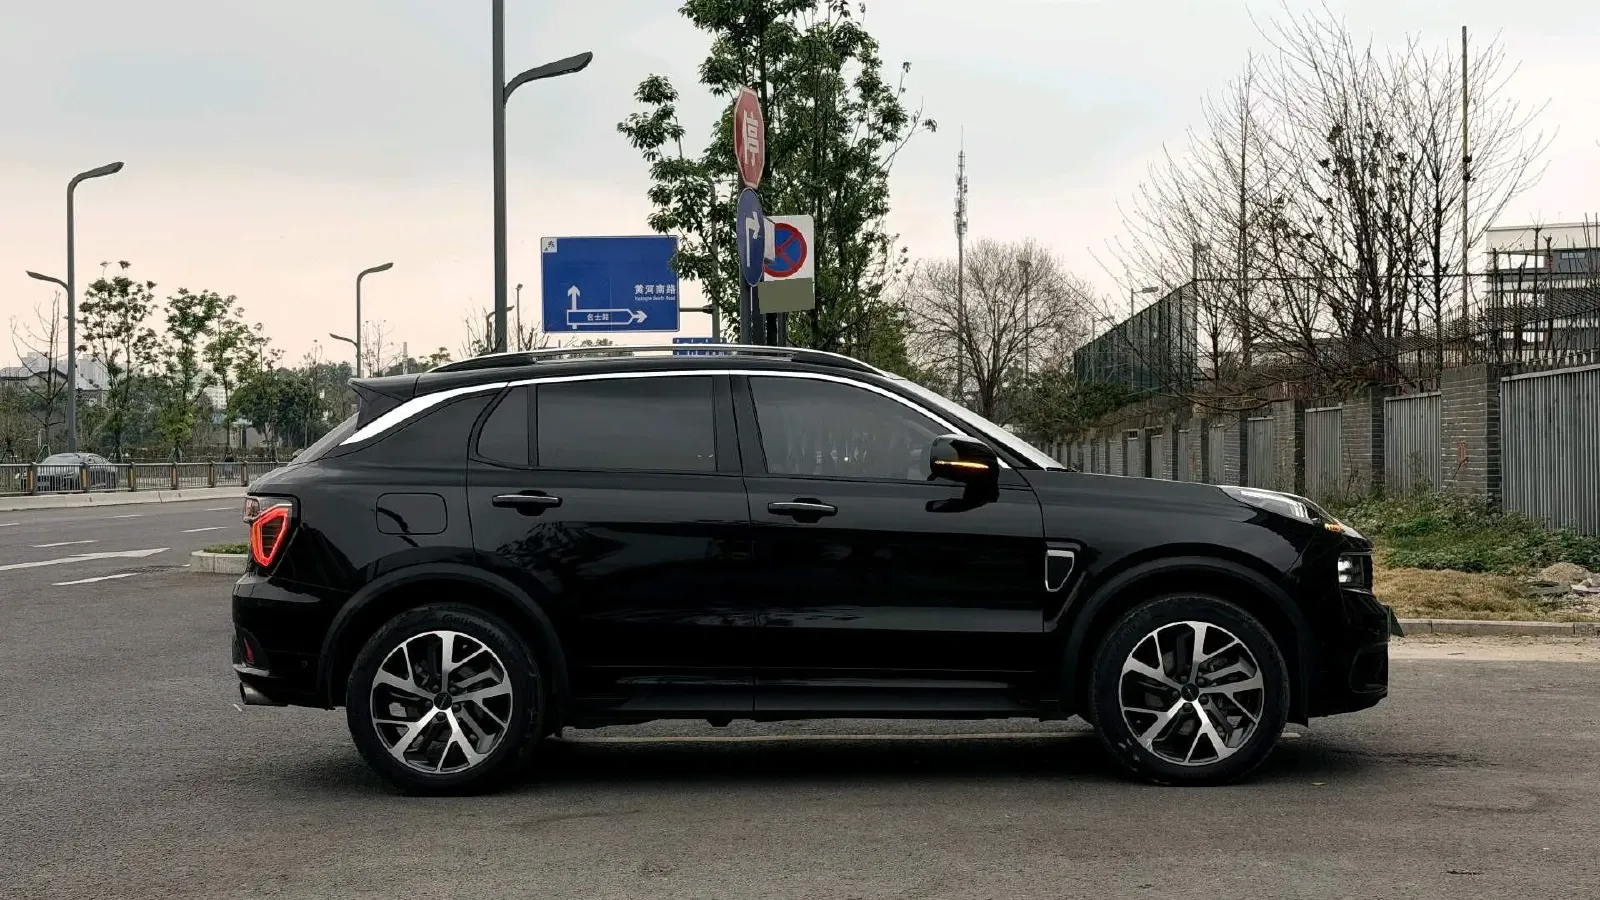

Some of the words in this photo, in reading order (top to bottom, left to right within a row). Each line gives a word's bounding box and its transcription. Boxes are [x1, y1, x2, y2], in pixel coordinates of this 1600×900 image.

[742, 109, 759, 167] 停
[634, 284, 676, 295] 黄河南路
